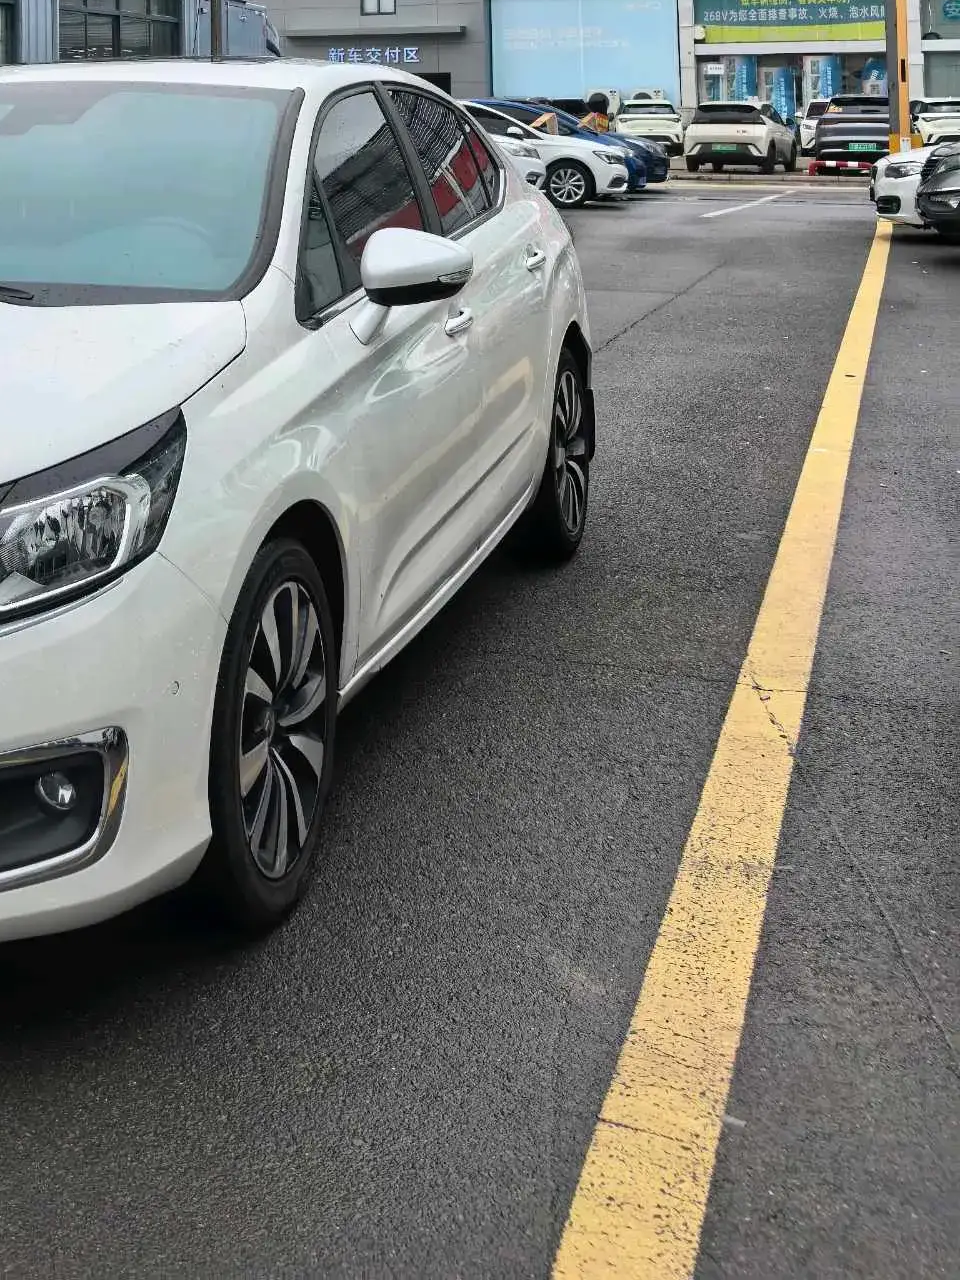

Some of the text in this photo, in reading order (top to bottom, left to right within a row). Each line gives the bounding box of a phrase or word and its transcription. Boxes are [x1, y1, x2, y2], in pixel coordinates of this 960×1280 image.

[328, 47, 420, 64] 新车交付区
